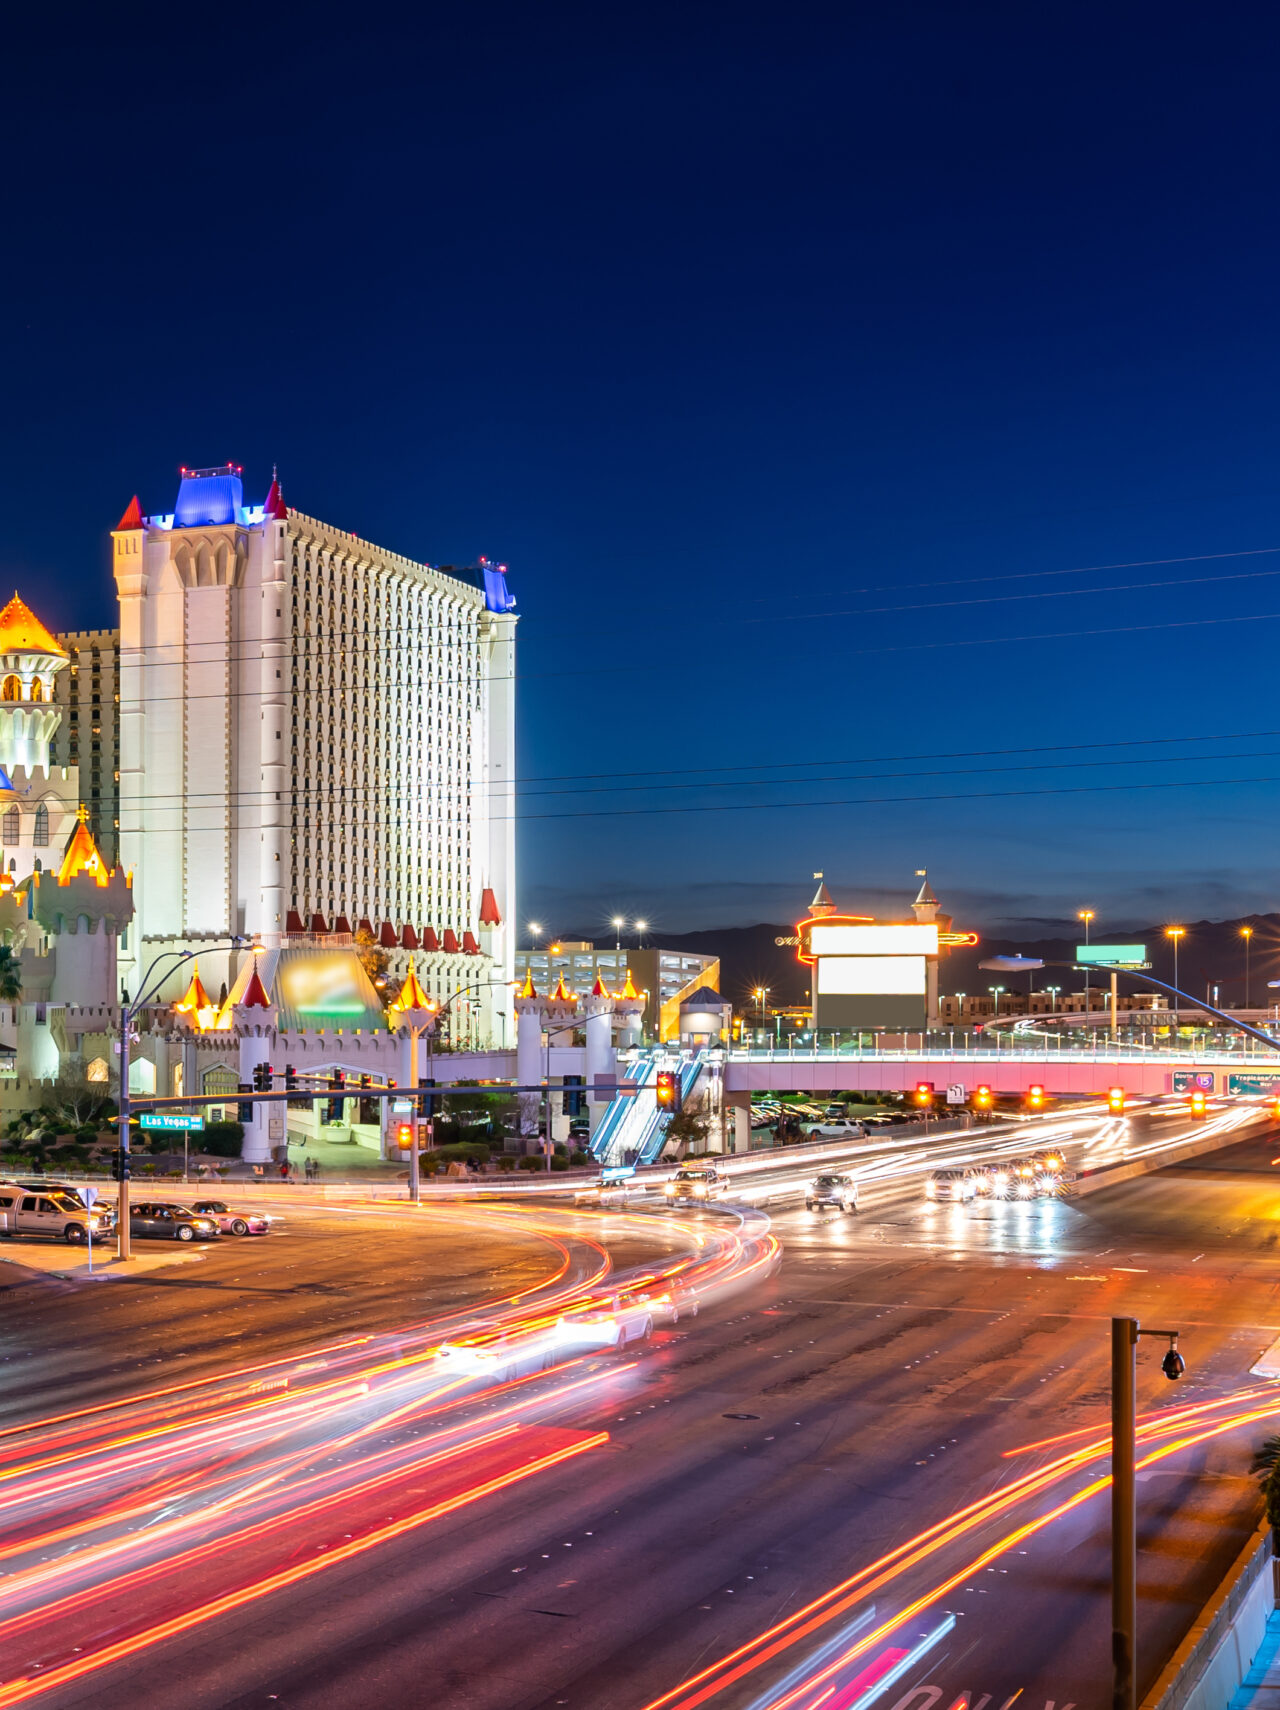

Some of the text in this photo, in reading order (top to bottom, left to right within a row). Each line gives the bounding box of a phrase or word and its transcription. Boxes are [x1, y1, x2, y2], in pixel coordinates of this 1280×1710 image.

[1200, 1076, 1210, 1086] 15
[146, 1115, 162, 1125] Las
[163, 1116, 189, 1128] Vegas
